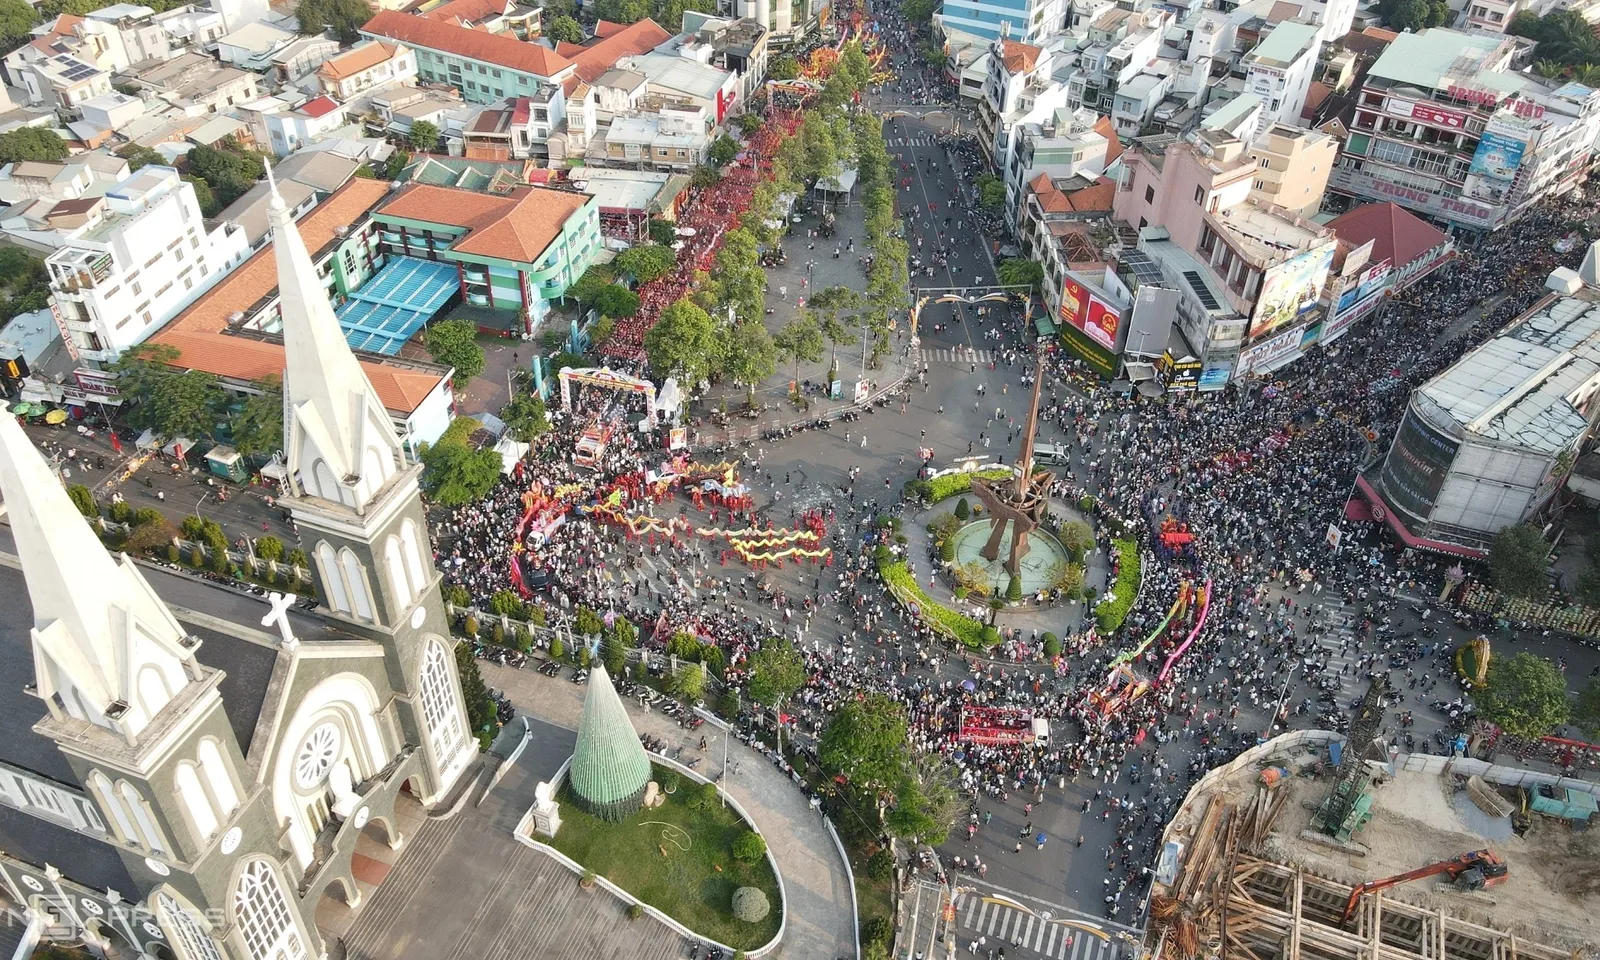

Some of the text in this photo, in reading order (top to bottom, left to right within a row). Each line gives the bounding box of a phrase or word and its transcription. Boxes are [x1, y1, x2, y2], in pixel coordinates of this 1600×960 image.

[1447, 85, 1497, 107] TRUNG
[1372, 180, 1429, 203] TRUNG
[1430, 437, 1455, 455] CENTER
[1416, 544, 1465, 557] HIGHLANDS
